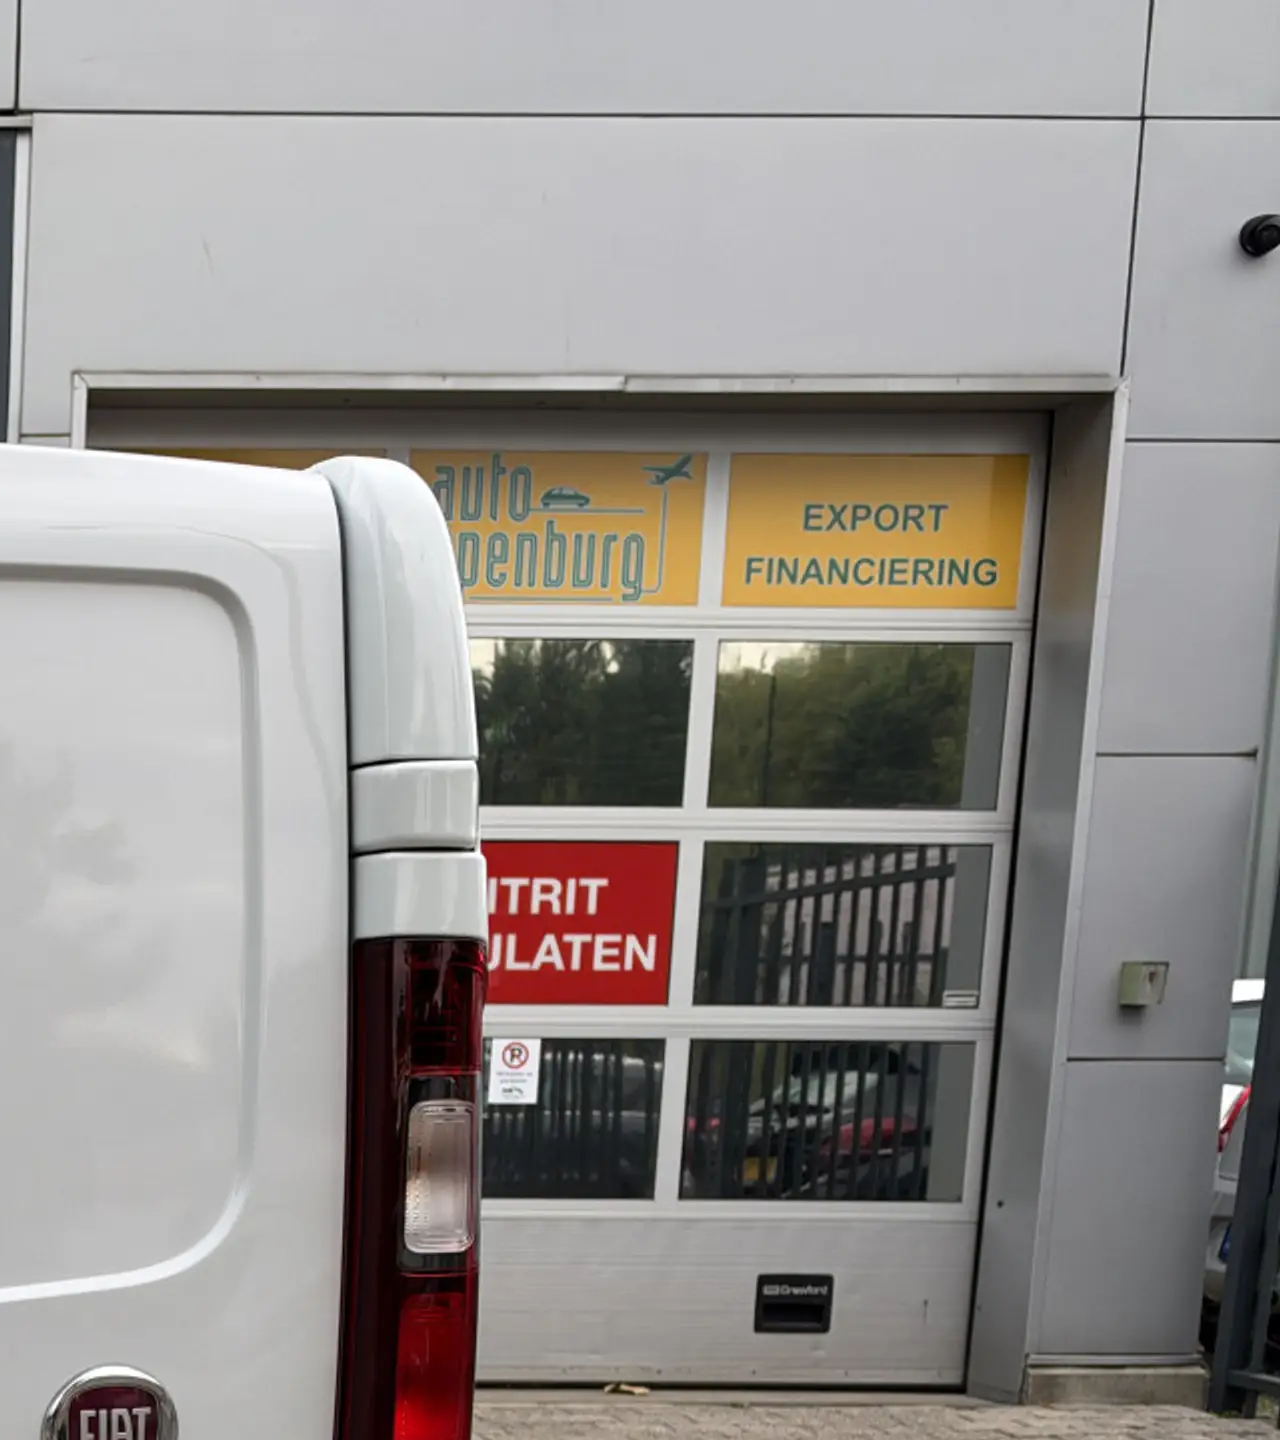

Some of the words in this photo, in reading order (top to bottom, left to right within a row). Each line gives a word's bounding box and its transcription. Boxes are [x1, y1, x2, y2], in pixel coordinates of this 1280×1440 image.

[433, 452, 533, 522] auto
[802, 502, 949, 533] EXPORT
[451, 519, 646, 602] penburg
[744, 556, 999, 587] FINANCIERING
[487, 876, 609, 916] ITRIT
[487, 932, 658, 972] JLATEN
